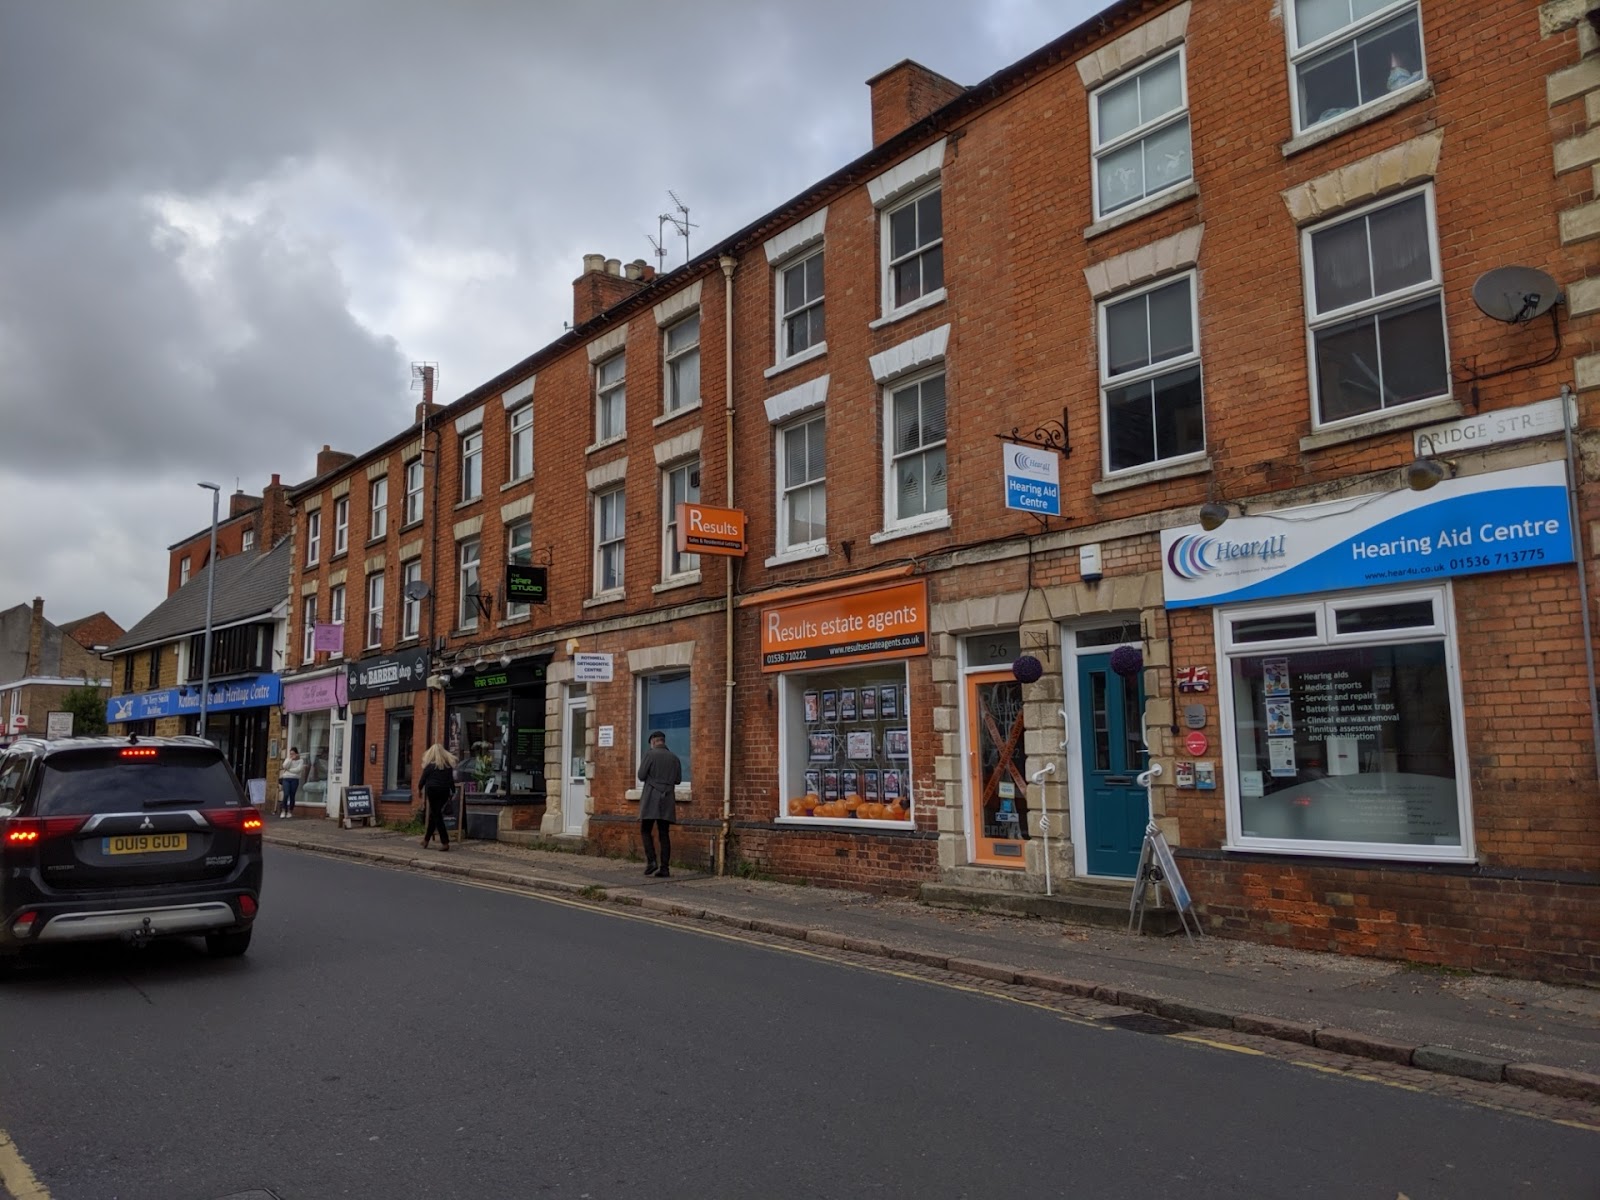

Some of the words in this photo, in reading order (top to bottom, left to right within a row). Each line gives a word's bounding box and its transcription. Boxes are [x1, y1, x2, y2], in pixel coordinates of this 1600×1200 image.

[1419, 424, 1487, 449] BRIDGE
[1498, 407, 1565, 433] STREE
[1009, 480, 1042, 497] Hearing
[1043, 486, 1057, 498] Aid
[1020, 495, 1048, 509] Centre
[690, 509, 738, 536] Results
[725, 541, 741, 549] Lettings
[1352, 536, 1432, 560] Hearing
[1437, 526, 1472, 549] Aid
[1479, 519, 1559, 544] Centre
[1215, 534, 1286, 561] Hear4U
[1364, 563, 1445, 580] www.hear4u.co.uk
[1449, 555, 1490, 570] 01536
[1494, 548, 1545, 566] 713775
[510, 584, 543, 592] STUDIO
[768, 612, 817, 643] Results
[821, 614, 863, 636] estate
[867, 605, 917, 632] agents
[766, 652, 785, 664] 01536
[785, 650, 807, 662] 710222
[829, 635, 920, 655] www.resultsestateagents.co.uk
[990, 643, 1007, 658] 26
[359, 672, 367, 685] the
[368, 666, 398, 685] BARBER
[399, 664, 411, 681] shop
[1303, 672, 1332, 681] Hearing
[1333, 671, 1349, 679] aids
[1305, 683, 1333, 691] Medical
[1334, 681, 1362, 691] reports
[224, 686, 249, 706] Heritage
[250, 683, 270, 700] Centre
[1305, 694, 1332, 702] Service
[1334, 693, 1349, 701] and
[1350, 691, 1377, 701] repairs
[1306, 704, 1339, 713] Batteries
[1341, 703, 1355, 712] and
[1374, 702, 1395, 711] traps
[1307, 716, 1334, 725] Clinical
[1350, 715, 1366, 723] wax
[1367, 713, 1400, 722] removal
[1308, 725, 1338, 733] Tinnitus
[1339, 724, 1383, 732] assessment
[1308, 734, 1322, 742] and
[1323, 732, 1376, 741] rehabilitation
[115, 837, 149, 851] OU19
[152, 835, 181, 850] GUD
